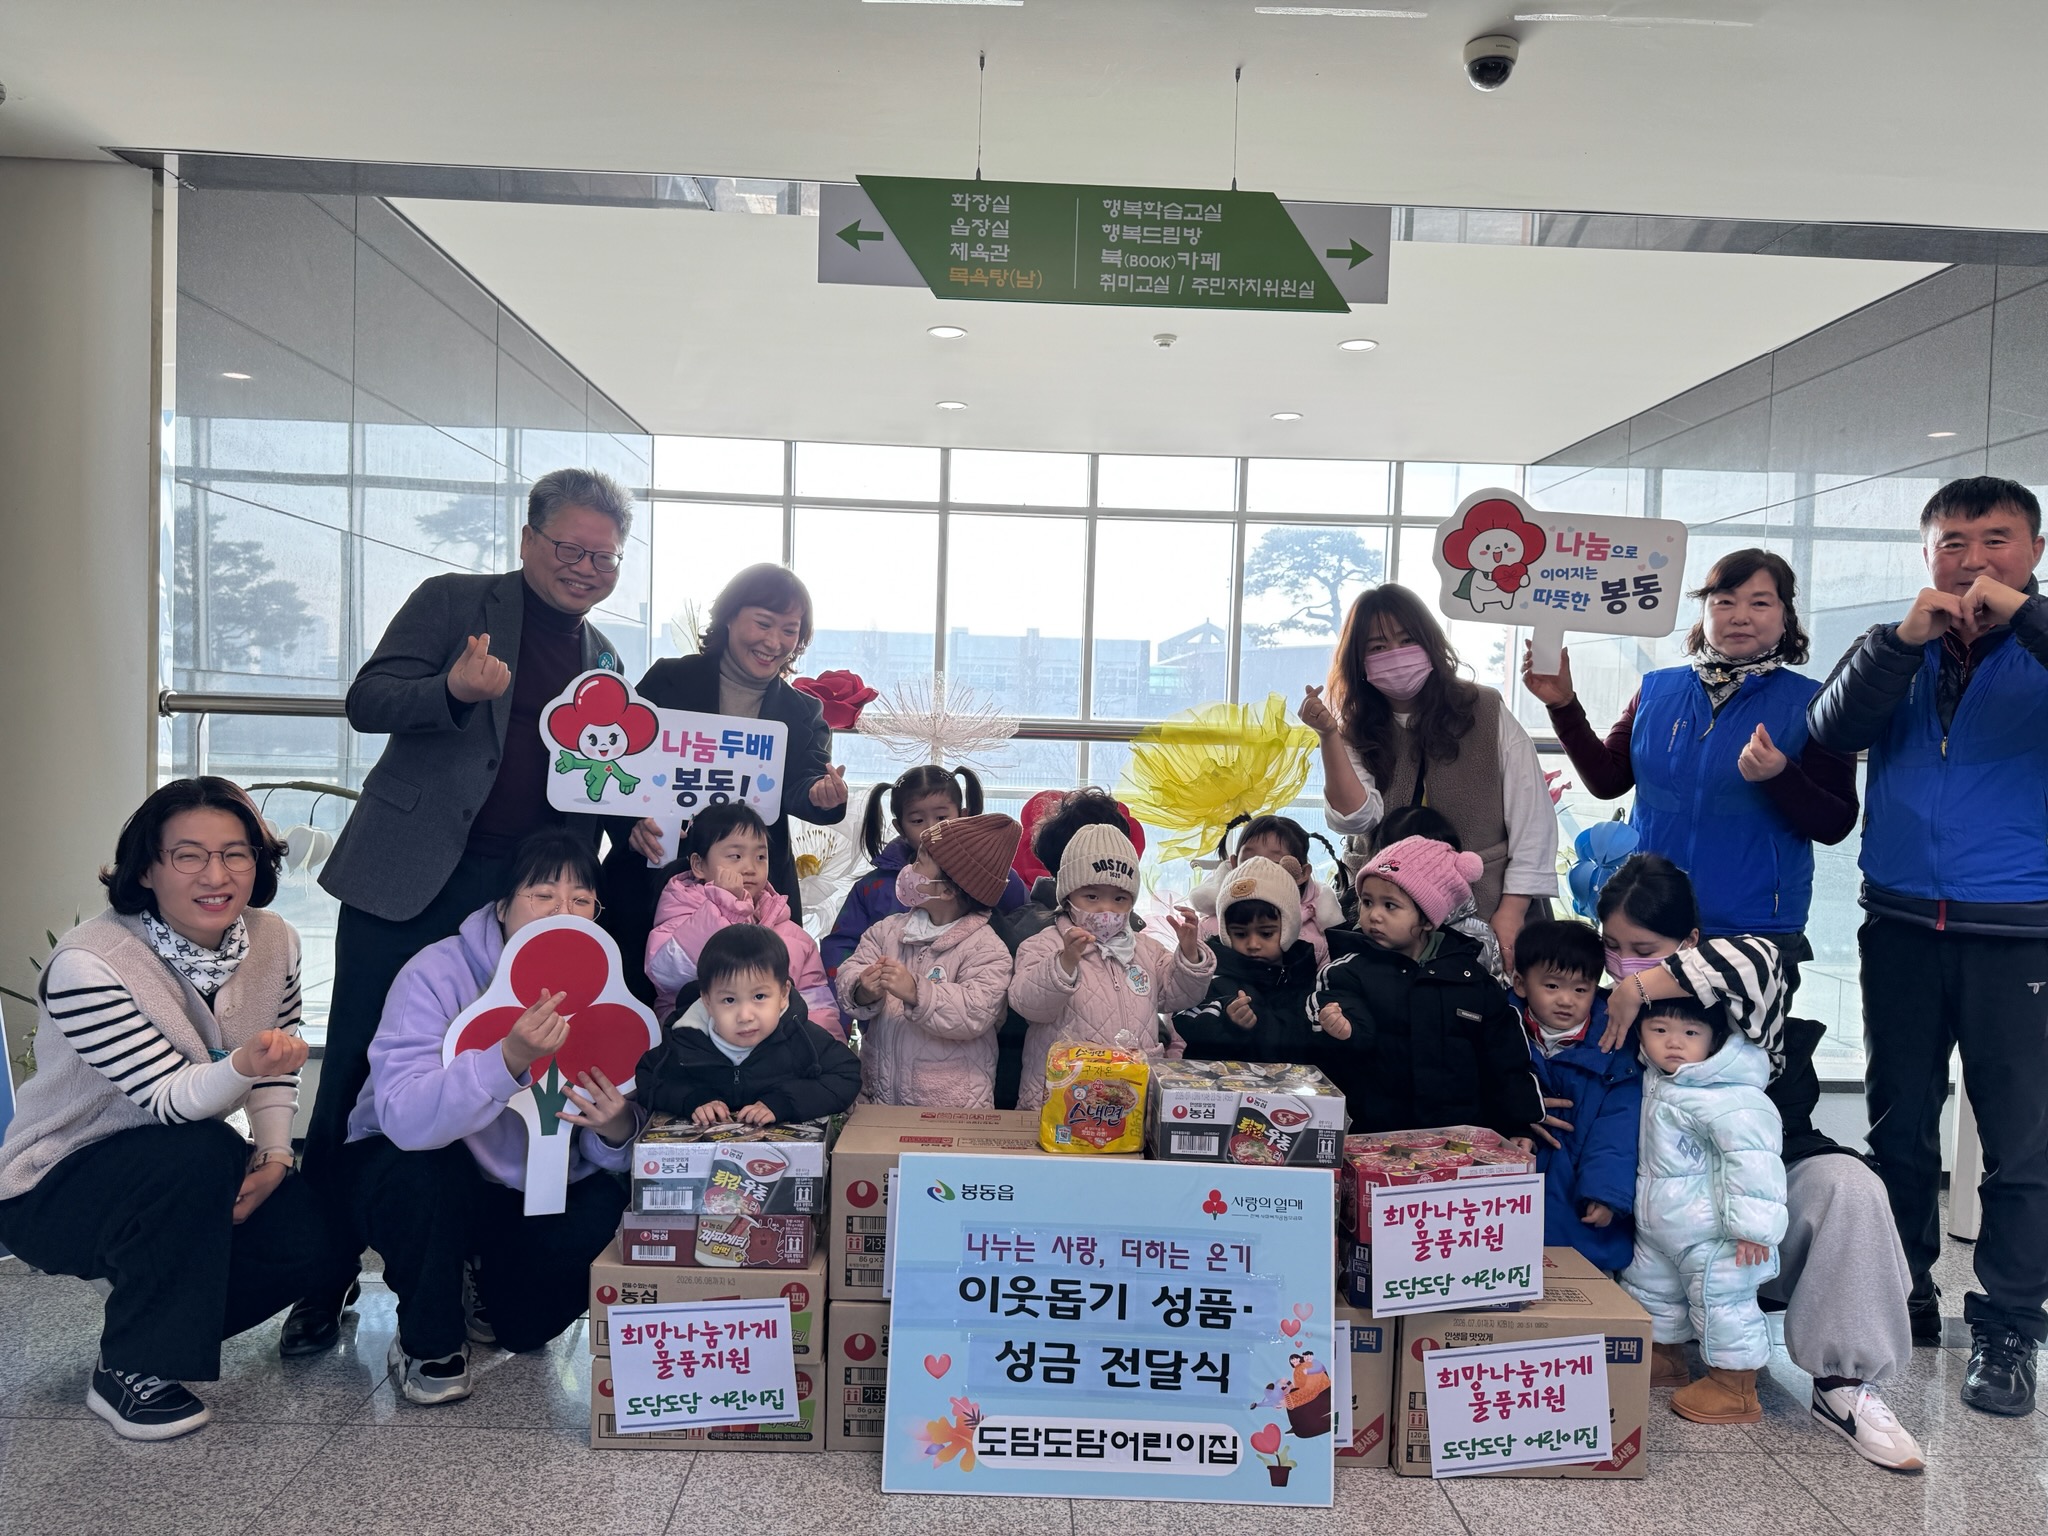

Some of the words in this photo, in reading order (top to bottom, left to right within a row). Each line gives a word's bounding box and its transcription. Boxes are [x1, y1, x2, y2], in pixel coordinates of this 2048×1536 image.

[951, 192, 1010, 213] 화장실
[1102, 198, 1223, 223] 행복학습교실
[950, 217, 1010, 239] 읍장실
[1101, 223, 1203, 245] 행복드림방
[949, 242, 1010, 263] 체육관
[1100, 248, 1221, 272] 북(BOOK)카페
[948, 267, 1043, 290] 목욕탕(남)
[1099, 273, 1170, 296] 취미교실
[1191, 276, 1315, 300] 주민자치위원실
[1555, 532, 1638, 561] 나눔으로
[1541, 567, 1598, 581] 이어지는
[1533, 588, 1590, 612] 따뜻한
[1601, 574, 1662, 614] 봉동
[662, 730, 774, 763] 나눔두배
[672, 767, 751, 808] 봉동!
[1092, 859, 1135, 880] BOSTON
[1068, 1100, 1124, 1126] 스낵면
[1189, 1108, 1216, 1119] 농심
[661, 1162, 689, 1174] 농심
[961, 1183, 1015, 1201] 봉동읍
[1231, 1196, 1271, 1212] 사랑의
[1274, 1198, 1303, 1213] 열매
[1383, 1194, 1532, 1228] 희망나눔가게
[699, 1229, 748, 1247] 짜파게티
[1412, 1223, 1504, 1262] 물품지원
[967, 1233, 1036, 1263] 나누는
[1052, 1235, 1105, 1268] 사랑,
[1121, 1239, 1190, 1270] 더하는
[1206, 1243, 1251, 1273] 온기
[1382, 1273, 1455, 1300] 도담도담
[1462, 1264, 1531, 1288] 어린이집
[620, 1289, 658, 1304] 농심
[959, 1275, 1128, 1320] 이웃돕기
[621, 1319, 777, 1349] 희망나눔가게
[1445, 1332, 1468, 1341] 인생을
[1469, 1332, 1494, 1341] 맛있게
[652, 1347, 751, 1380] 물품지원
[995, 1340, 1080, 1384] 성금
[1100, 1345, 1231, 1394] 전달식
[1437, 1355, 1593, 1390] 희망나눔가게
[626, 1391, 703, 1418] 도담도담
[709, 1388, 785, 1411] 어린이집
[1468, 1384, 1566, 1423] 물품지원
[977, 1425, 1238, 1465] 도담도담어린이집
[1353, 1429, 1379, 1453] 행사용
[1441, 1433, 1517, 1461] 도담도담
[1524, 1425, 1598, 1450] 어린이집
